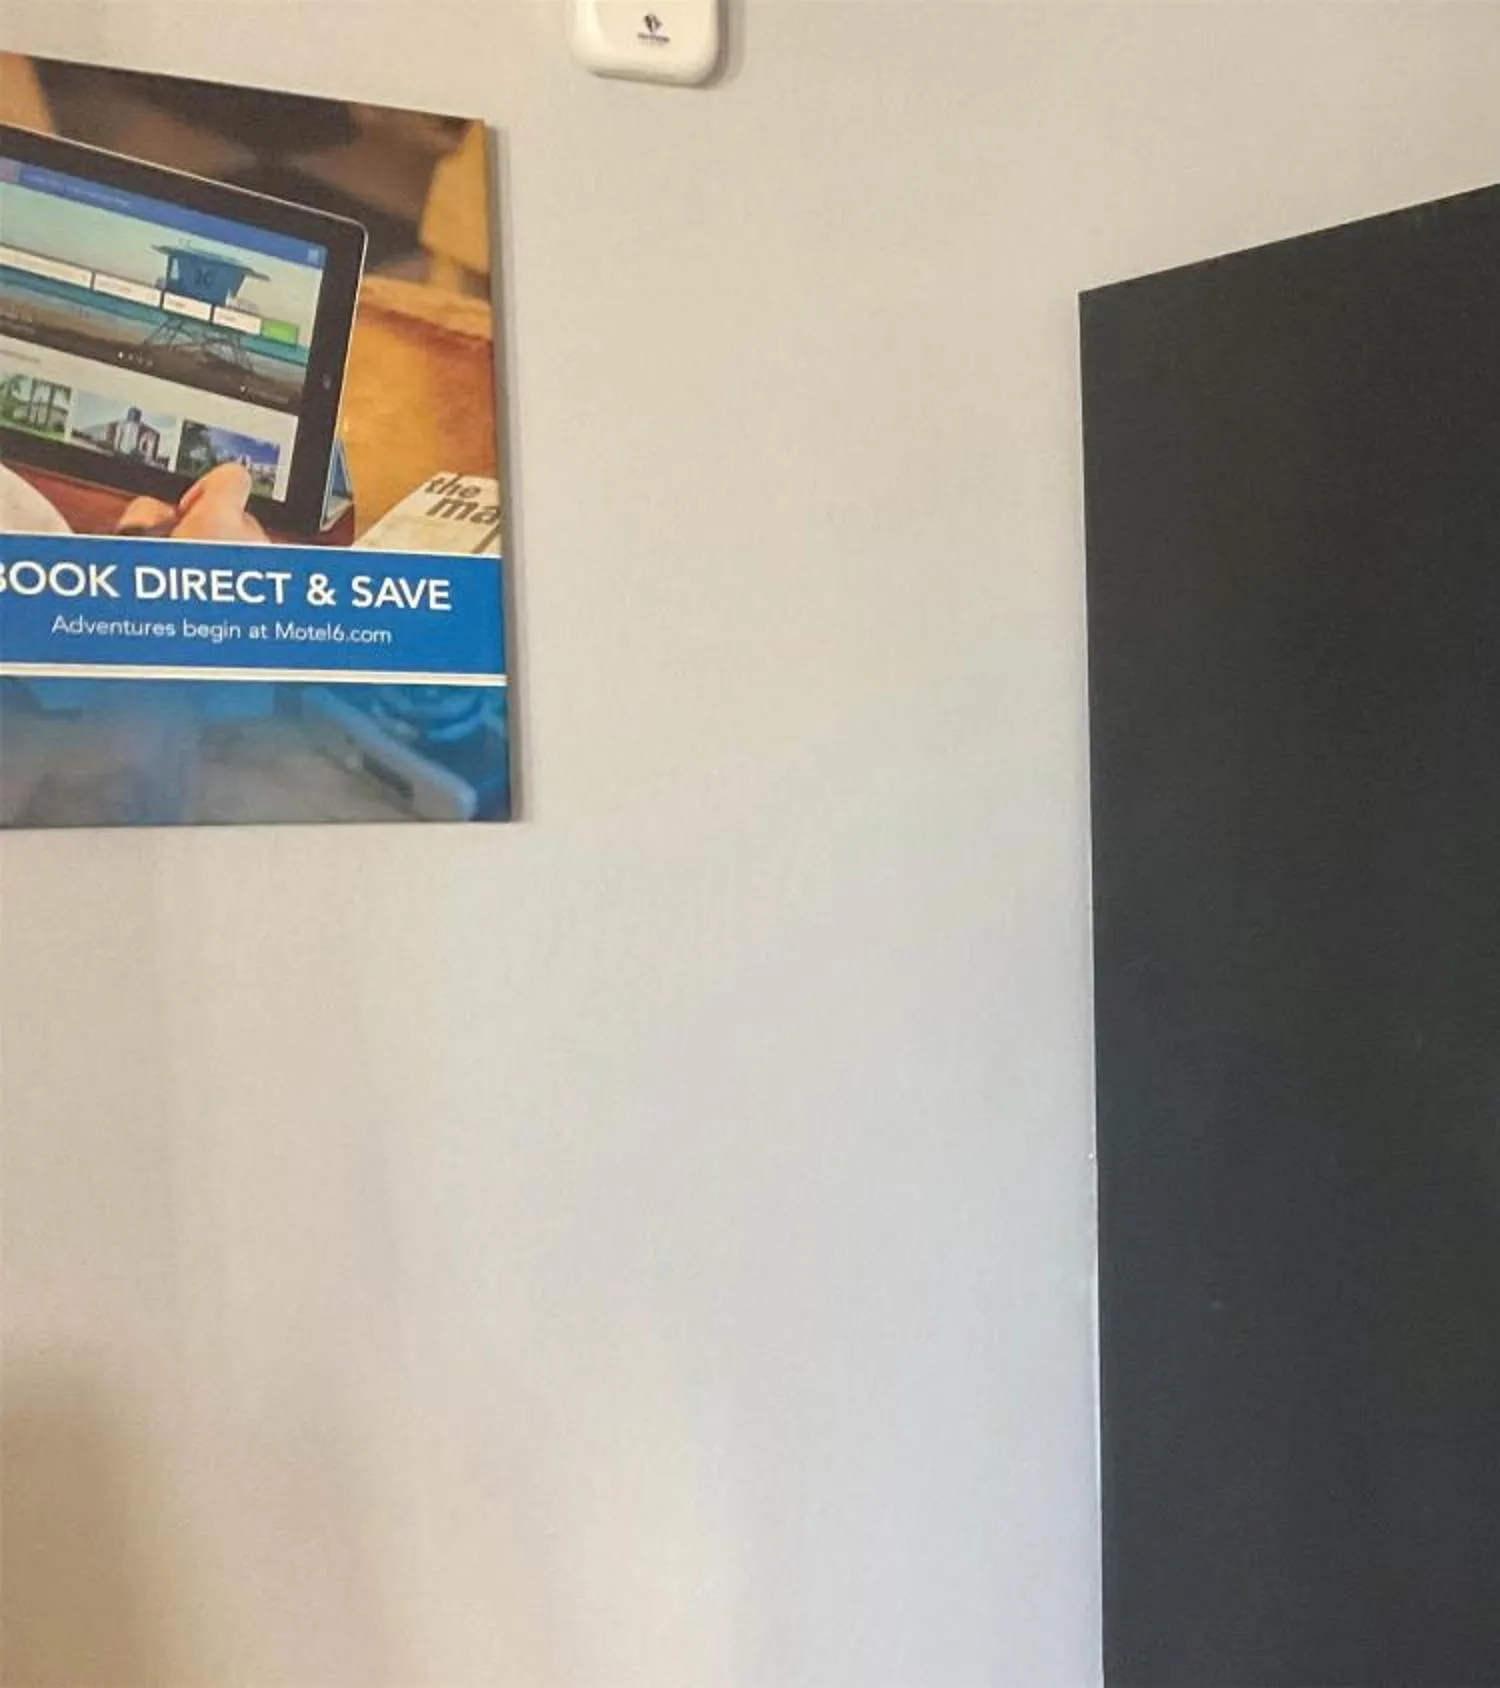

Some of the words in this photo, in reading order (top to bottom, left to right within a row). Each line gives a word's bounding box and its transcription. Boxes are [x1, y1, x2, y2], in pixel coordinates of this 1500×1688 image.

[425, 472, 482, 498] the
[0, 560, 121, 598] OOK
[134, 565, 293, 605] DIRECT
[306, 573, 337, 606] &
[351, 575, 453, 611] SAVE
[51, 614, 176, 636] Adventures
[183, 618, 241, 644] begin
[249, 623, 267, 639] at
[275, 621, 391, 643] Motel6.com
